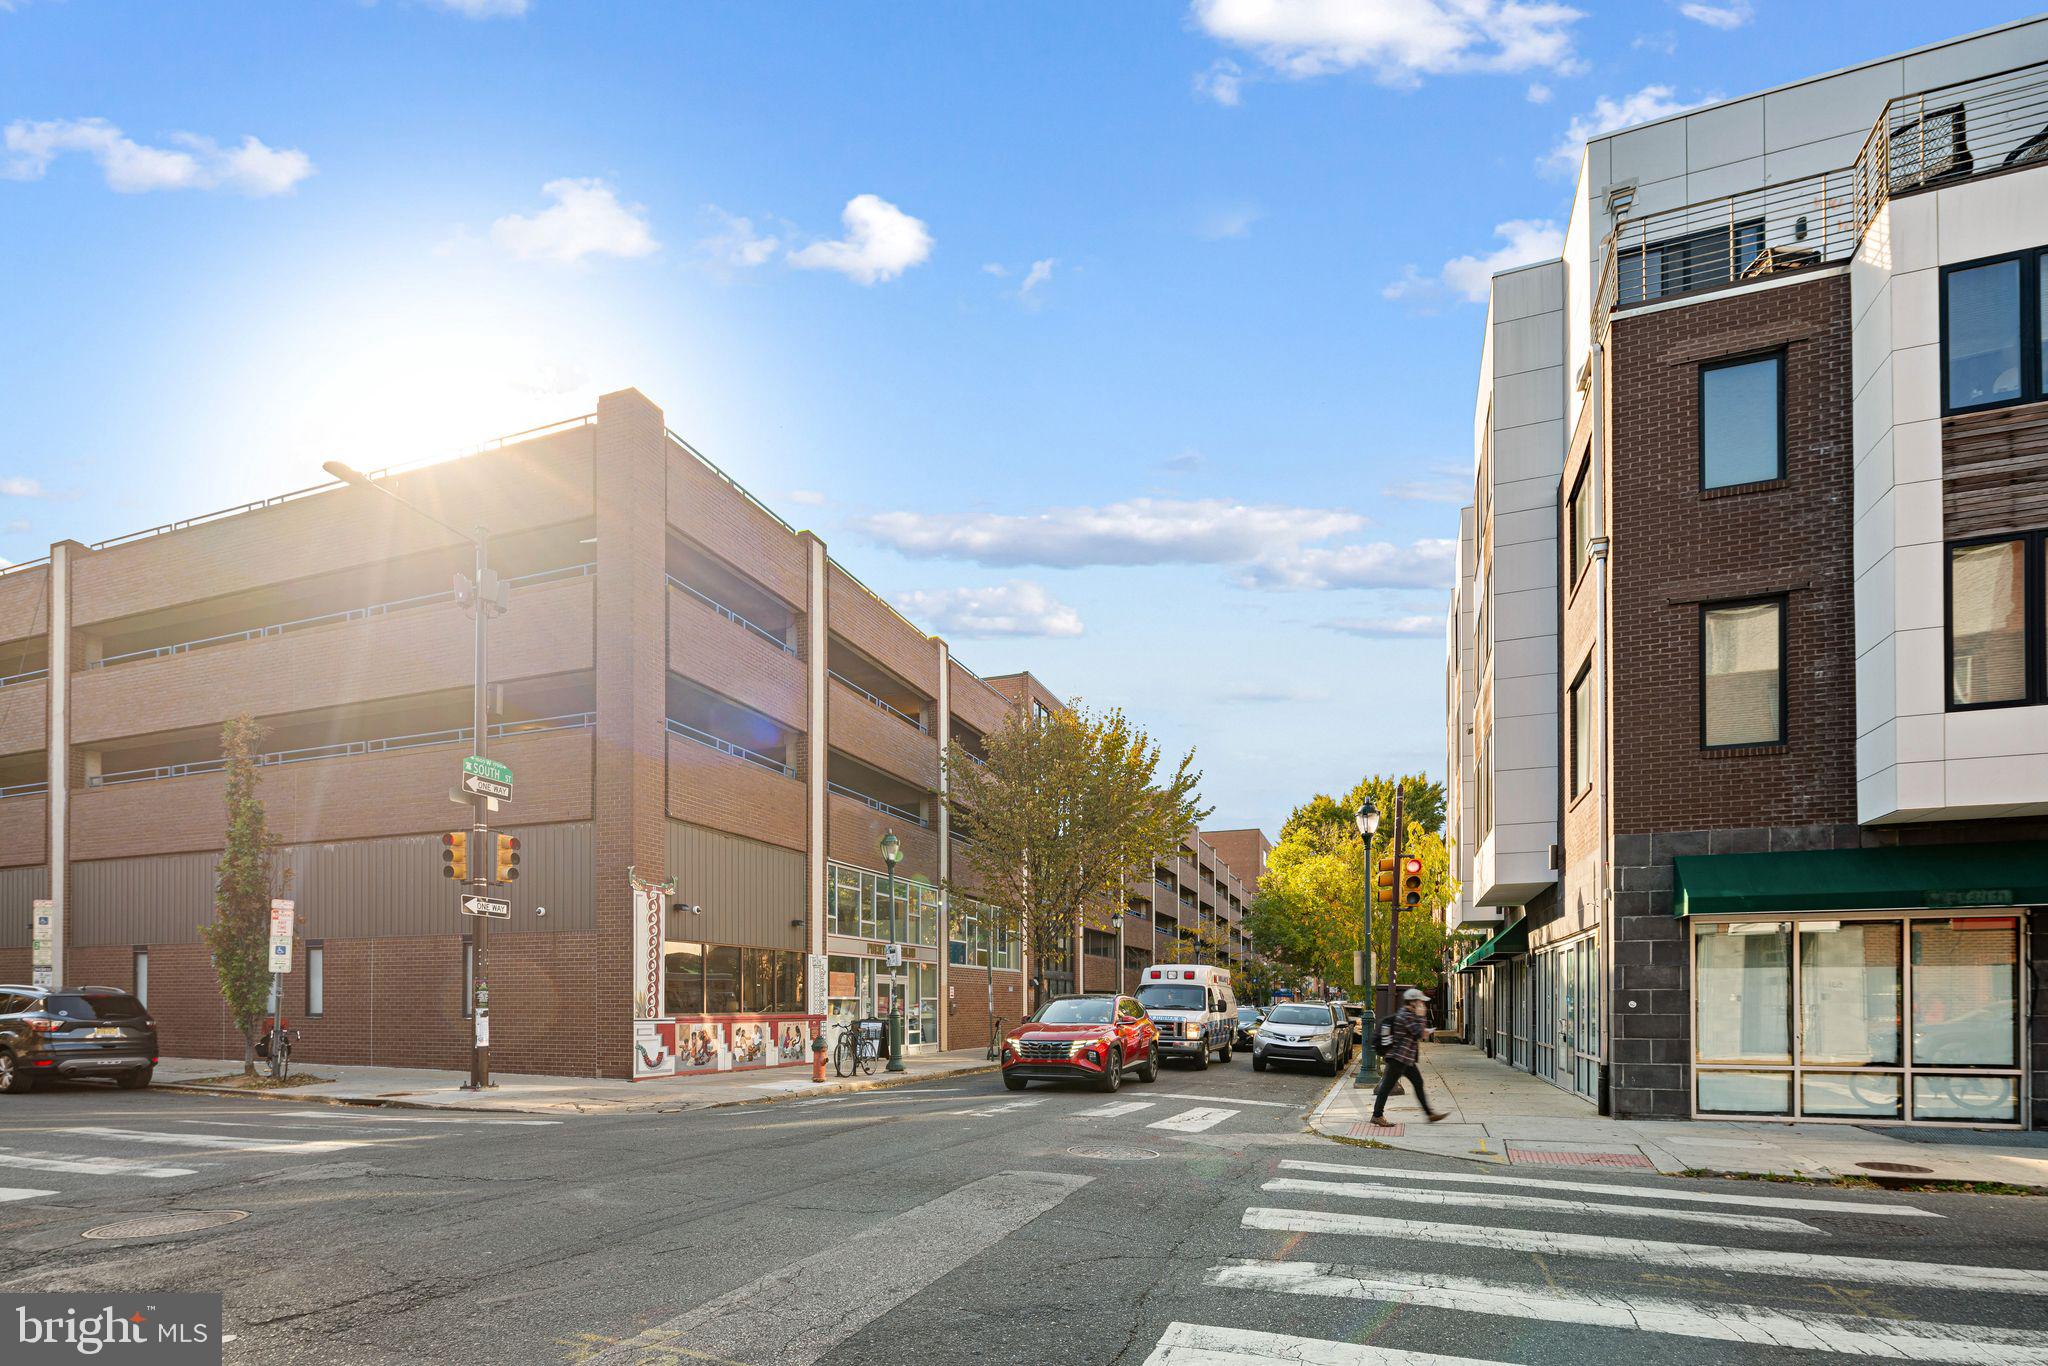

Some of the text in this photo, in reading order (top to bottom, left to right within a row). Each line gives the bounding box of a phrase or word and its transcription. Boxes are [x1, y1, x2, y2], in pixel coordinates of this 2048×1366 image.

[473, 763, 500, 780] SOUTH
[504, 775, 511, 783] ST
[478, 781, 507, 795] ONE WAY
[476, 902, 505, 912] ONE WAY
